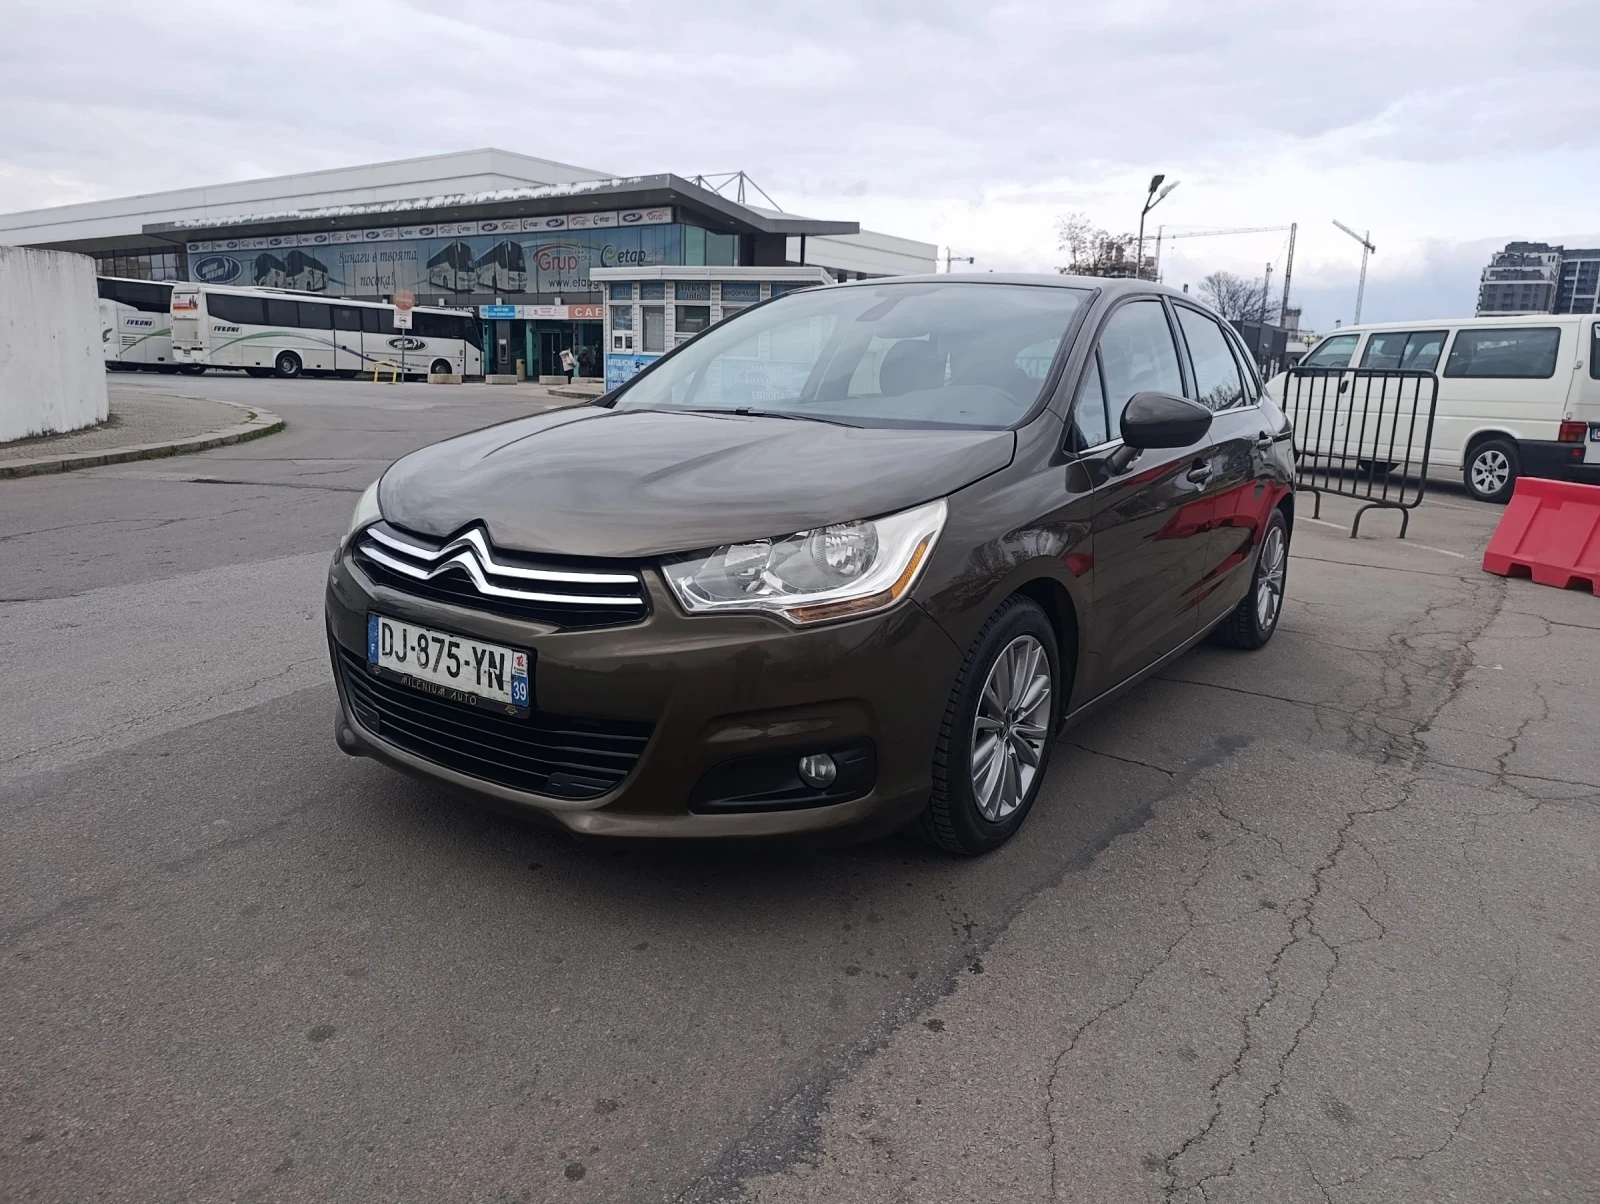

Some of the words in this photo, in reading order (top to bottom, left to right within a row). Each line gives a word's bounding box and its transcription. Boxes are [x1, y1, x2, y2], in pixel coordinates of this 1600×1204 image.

[338, 251, 370, 265] Винаги
[372, 250, 377, 262] в
[379, 250, 418, 262] твоята
[537, 250, 578, 274] Grup
[360, 272, 395, 290] посока!
[548, 278, 602, 290] www.etapg
[679, 283, 709, 292] Tickets
[686, 291, 703, 300] info
[371, 643, 376, 654] F
[381, 622, 505, 691] DJ-875-YN
[400, 676, 446, 696] MILENIUM
[451, 691, 477, 706] AUTO
[513, 682, 527, 701] 39
